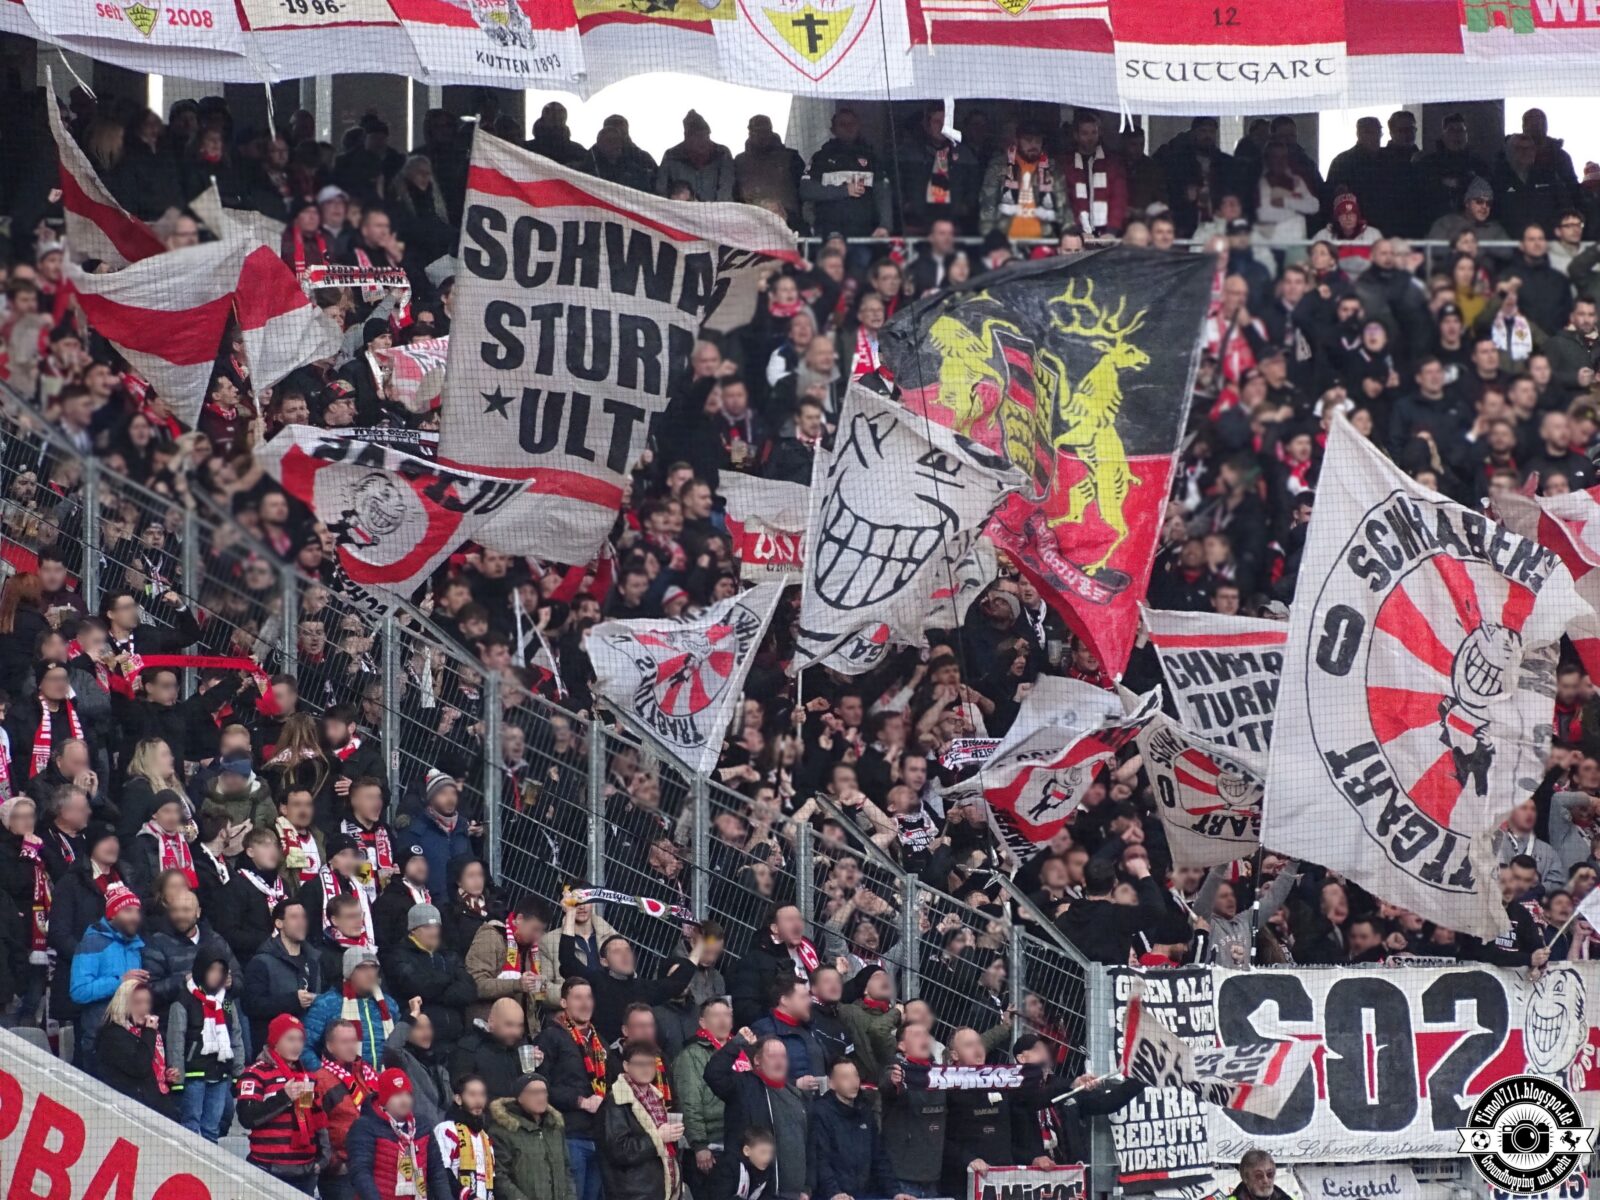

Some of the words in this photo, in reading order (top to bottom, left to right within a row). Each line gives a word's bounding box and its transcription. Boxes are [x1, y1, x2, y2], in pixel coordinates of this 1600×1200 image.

[165, 8, 213, 28] 2008
[1212, 8, 1240, 26] 12
[476, 50, 530, 74] KUTTEN
[534, 53, 561, 73] 1893
[1125, 57, 1337, 84] STUTTGART
[518, 387, 672, 476] ULT
[1289, 1137, 1443, 1159] Schwabensturm
[1322, 1174, 1402, 1198] Leintal
